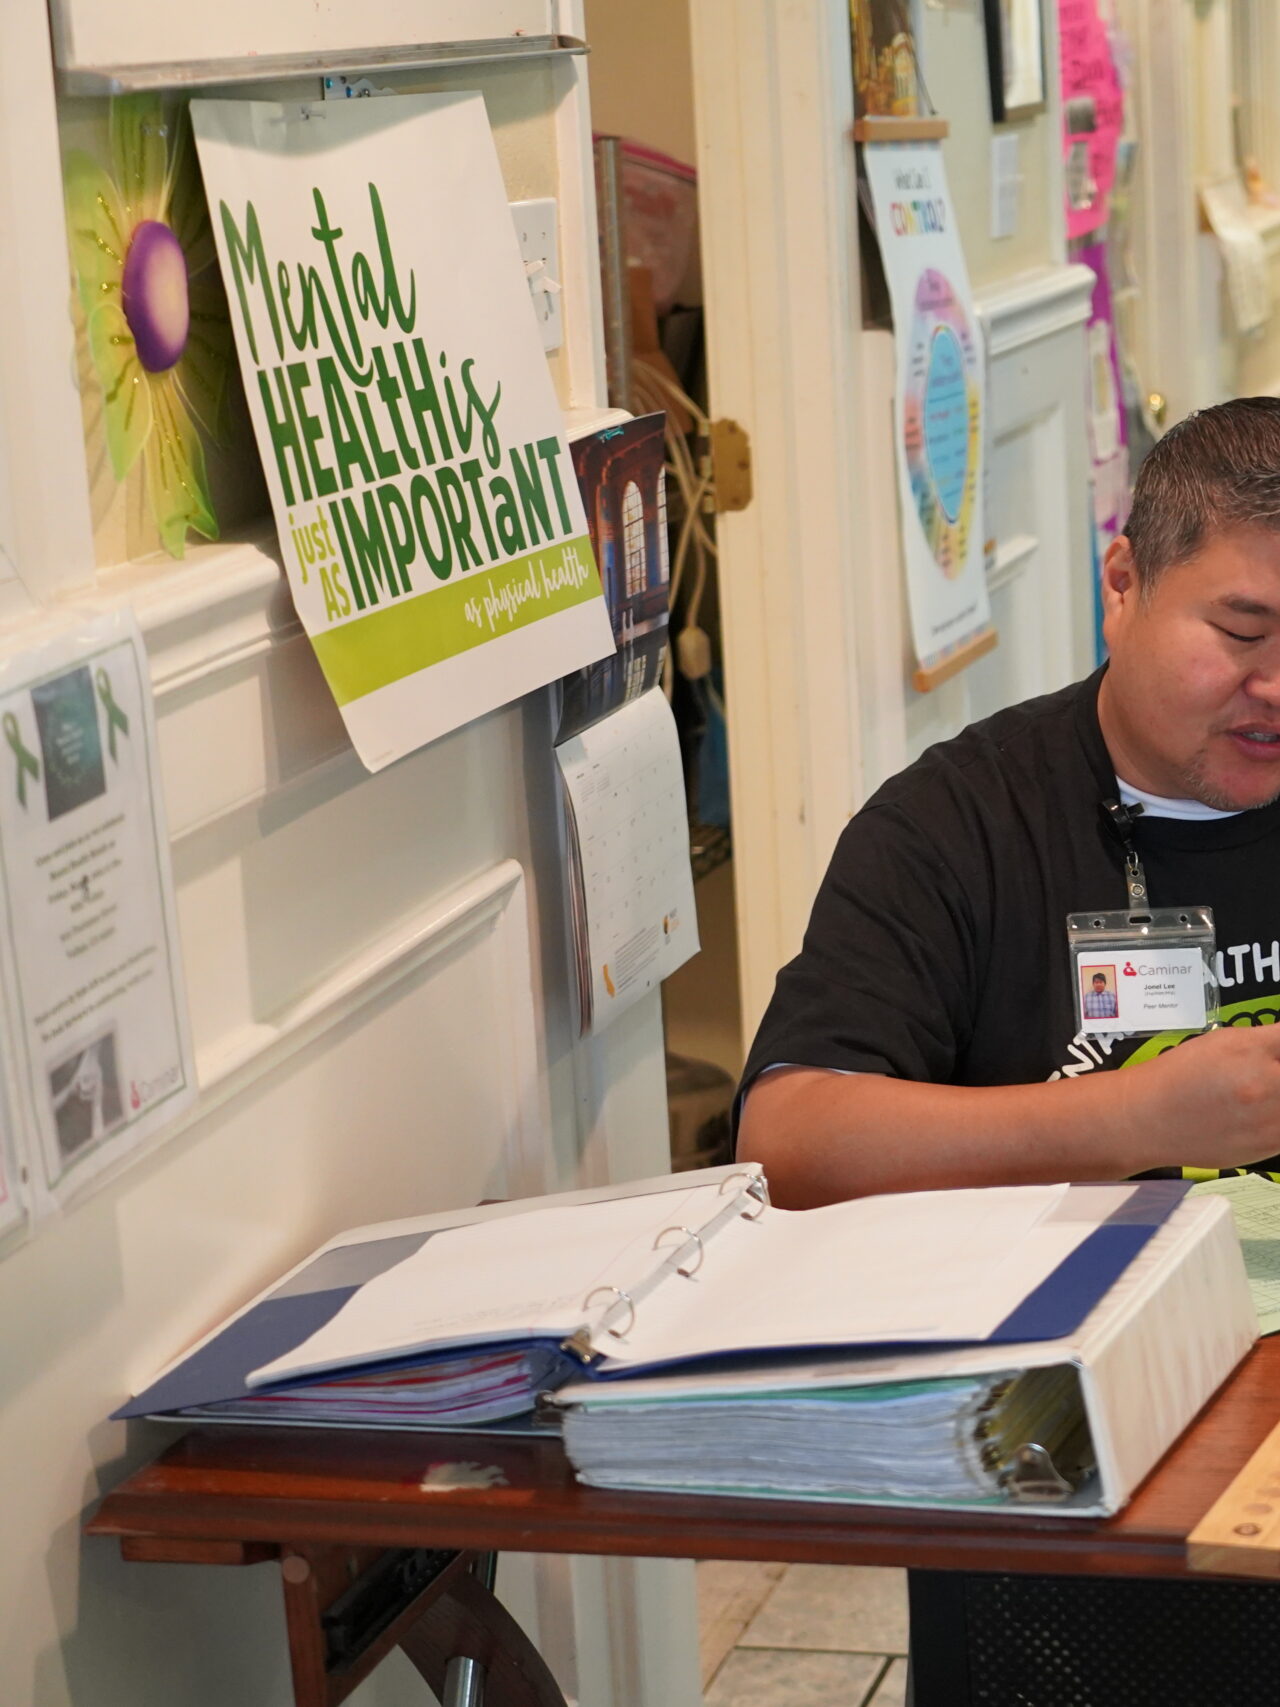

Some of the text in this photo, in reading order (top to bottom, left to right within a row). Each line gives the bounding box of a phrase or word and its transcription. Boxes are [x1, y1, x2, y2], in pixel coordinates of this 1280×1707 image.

[219, 182, 416, 387] Mental
[288, 504, 337, 585] just
[464, 546, 590, 633] as physical health
[1138, 965, 1192, 976] Caminar
